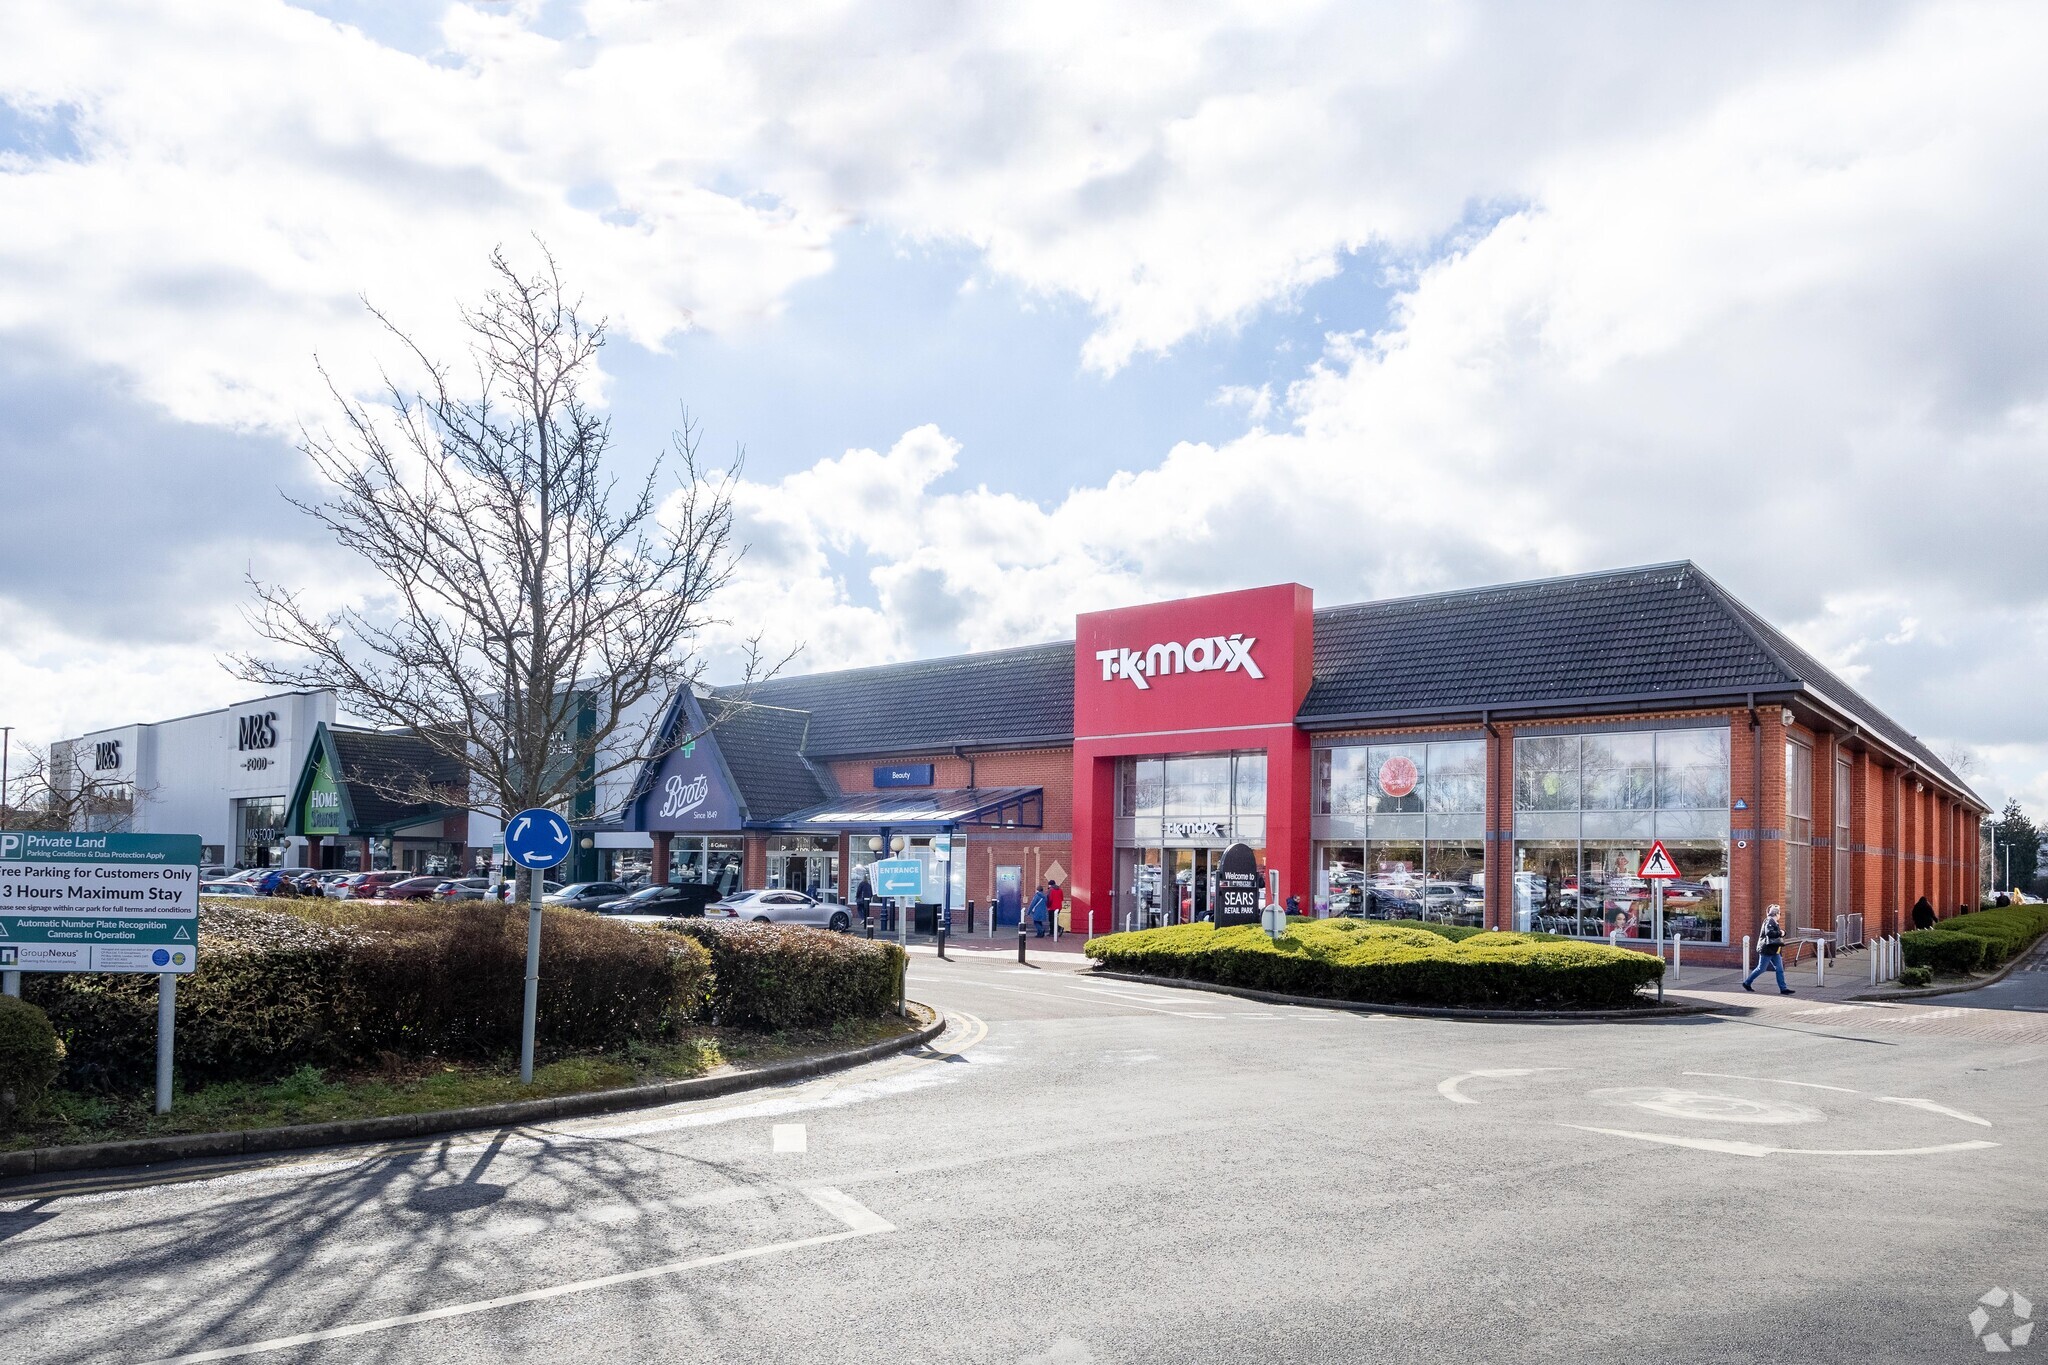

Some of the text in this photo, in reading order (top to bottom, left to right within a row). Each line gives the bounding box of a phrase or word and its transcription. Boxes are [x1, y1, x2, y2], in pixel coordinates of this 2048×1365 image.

[239, 711, 277, 751] M&S
[95, 740, 121, 771] M&S
[246, 757, 268, 771] FOOD
[892, 771, 911, 781] Beauty
[660, 774, 709, 818] Boots
[693, 810, 718, 819] Since 1849
[246, 828, 276, 841] M&S FOOD
[26, 835, 107, 848] Private Land
[26, 849, 51, 858] Parking
[87, 850, 94, 858] &
[111, 851, 145, 859] Protection
[145, 852, 166, 860] Apply
[24, 866, 71, 880] Parking
[73, 867, 92, 878] for
[94, 868, 160, 879] Customers
[162, 869, 192, 881] Only
[880, 866, 919, 874] ENTRANCE
[1224, 871, 1255, 880] Welcome to
[2, 884, 183, 903] 3 Hours Maximum Stay
[1224, 891, 1254, 906] SEARS
[27, 904, 52, 912] signage
[52, 904, 74, 912] within
[86, 905, 101, 913] park
[157, 906, 192, 914] conditions
[1224, 906, 1254, 914] RETAIL PARK
[16, 919, 167, 931] Automatic Number Plate Recognition
[47, 930, 136, 940] Cameras In Operation
